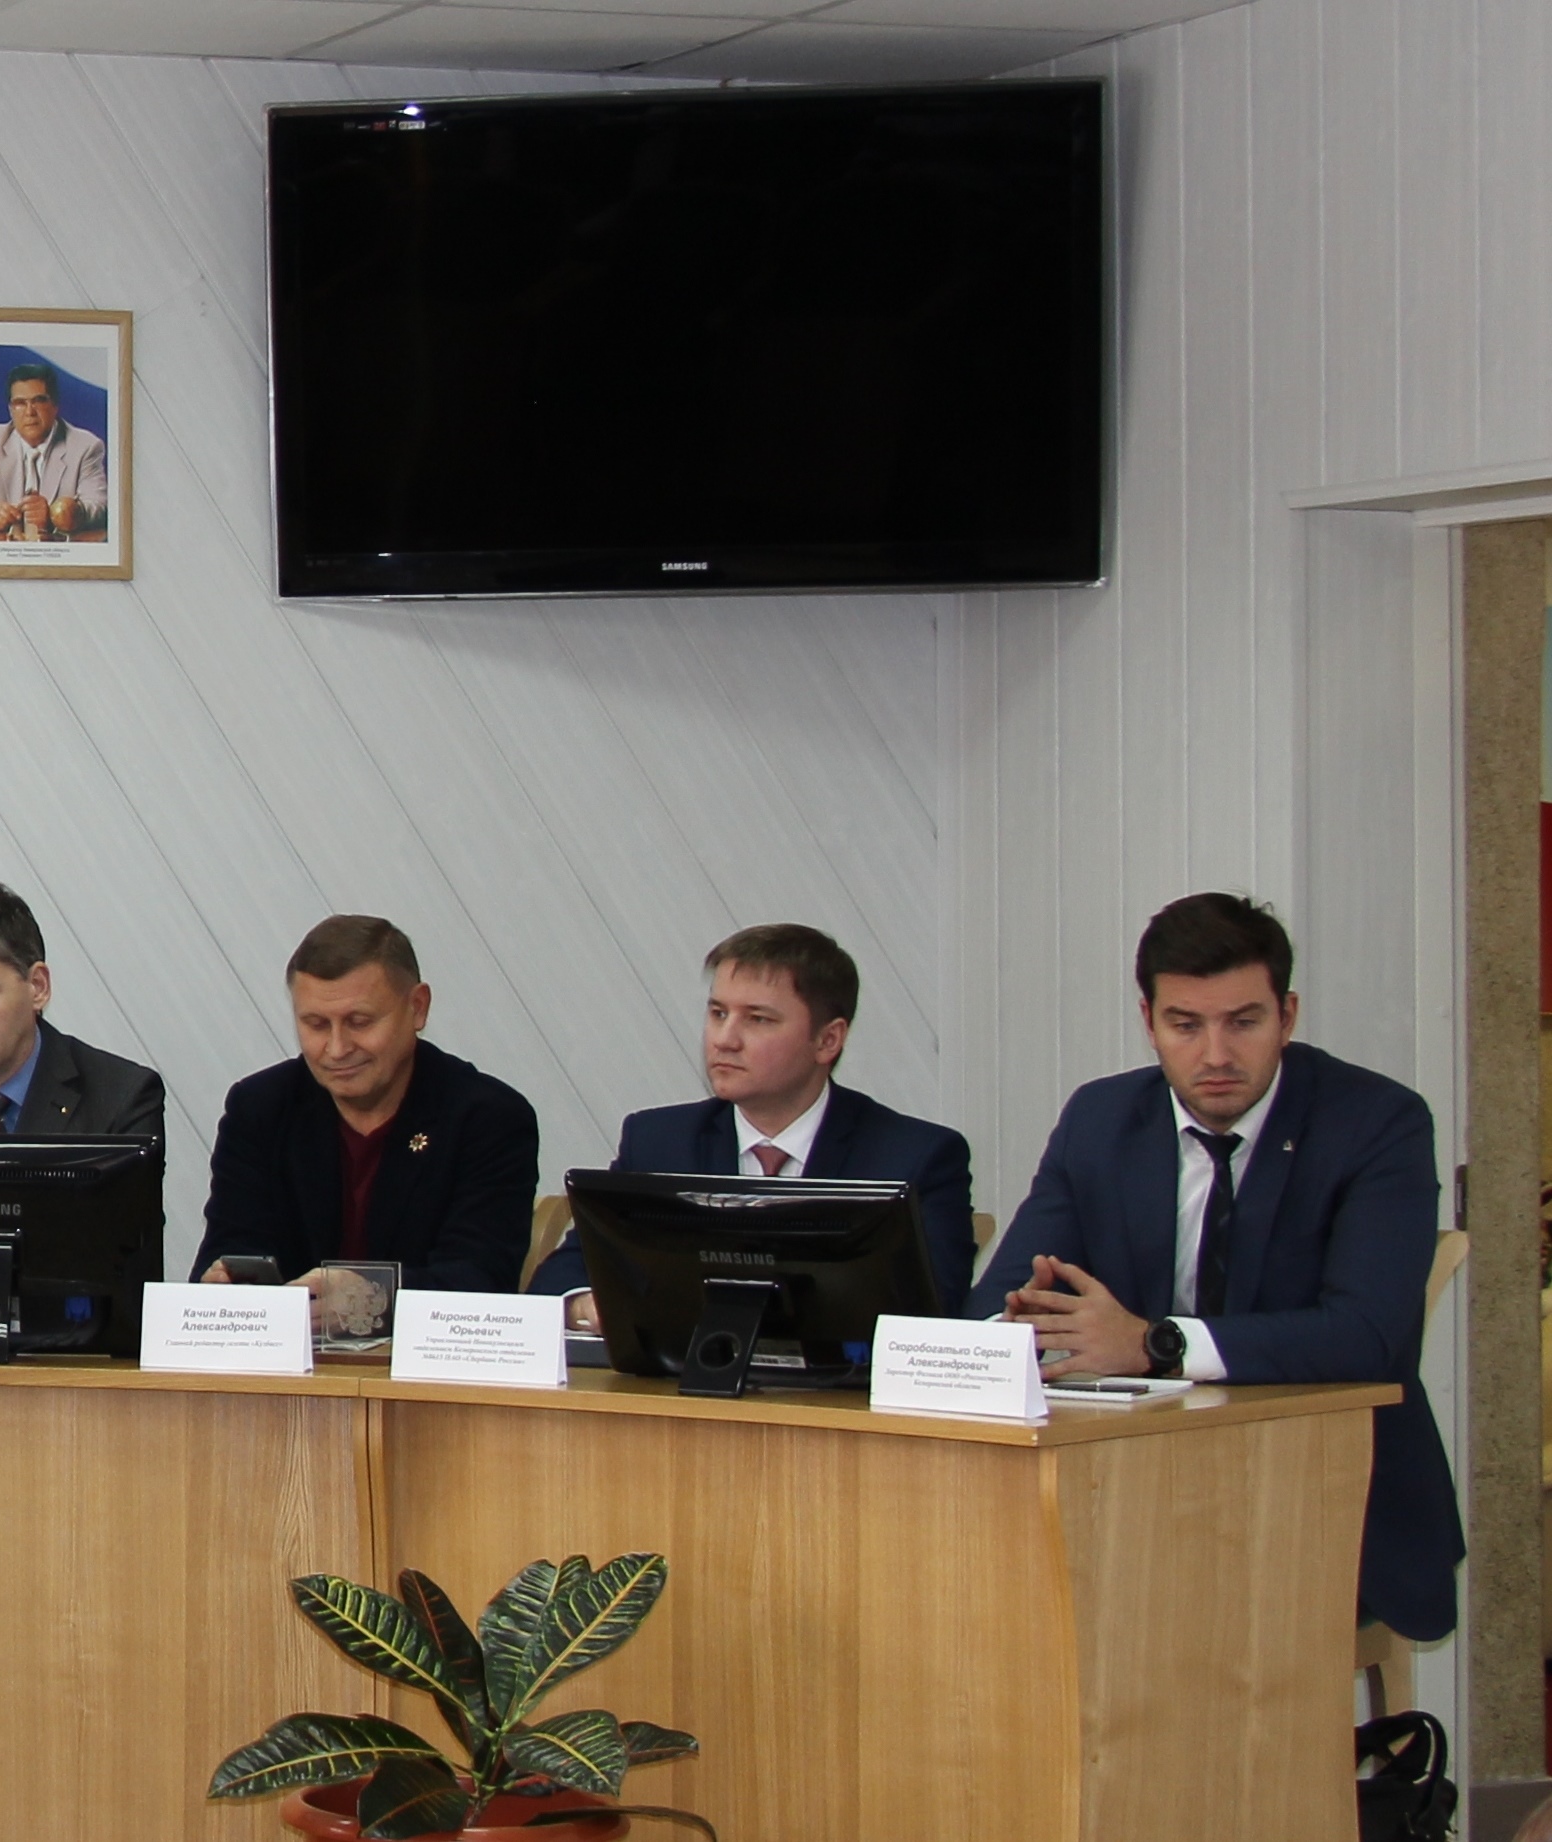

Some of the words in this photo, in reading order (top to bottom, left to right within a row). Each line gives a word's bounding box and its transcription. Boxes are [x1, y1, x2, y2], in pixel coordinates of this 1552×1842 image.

[662, 562, 708, 570] SAMSUNG
[699, 1251, 775, 1266] SAMSUNG
[183, 1308, 217, 1318] Качин
[219, 1308, 267, 1320] Валерий
[430, 1311, 480, 1322] Миронов
[484, 1313, 522, 1324] Антон
[182, 1321, 268, 1333] Александрович
[449, 1325, 502, 1337] Юрьевич
[888, 1341, 970, 1356] Скоробогатько
[973, 1346, 1011, 1359] Сергей
[907, 1356, 989, 1371] Александрович
